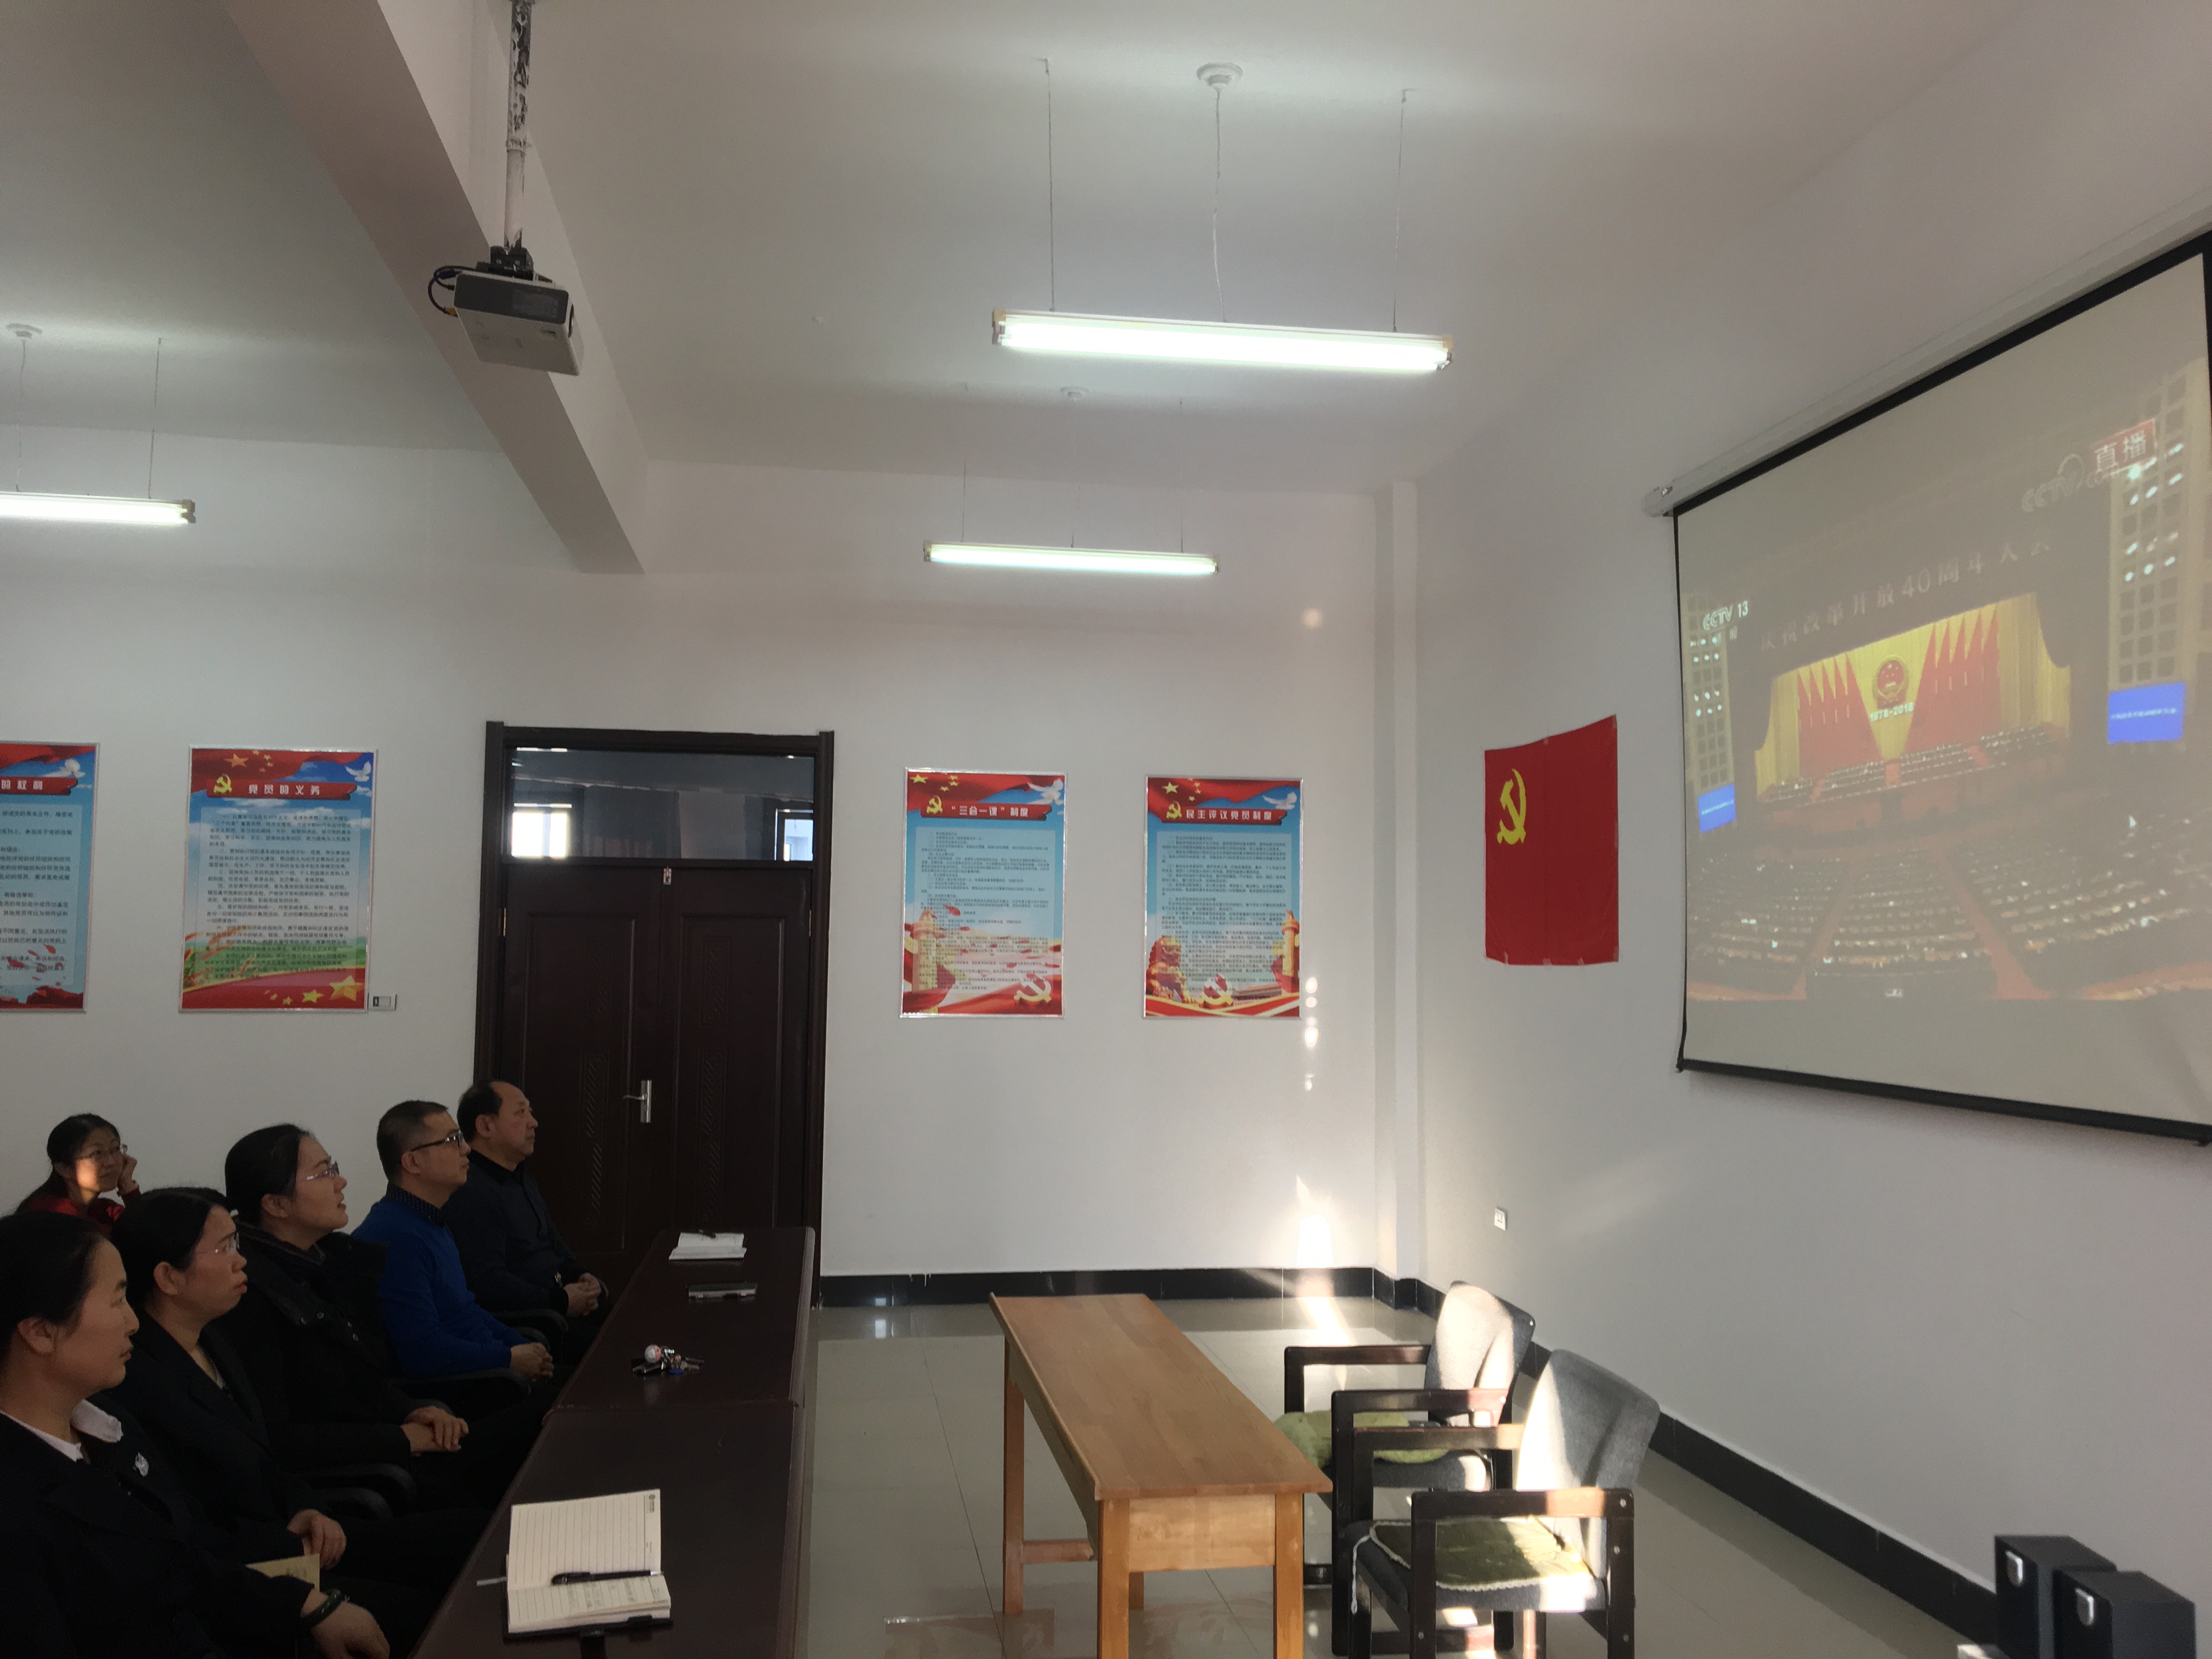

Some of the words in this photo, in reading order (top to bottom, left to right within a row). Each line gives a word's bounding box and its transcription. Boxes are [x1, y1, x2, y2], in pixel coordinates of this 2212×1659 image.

[2095, 430, 2147, 472] 直播
[1702, 604, 1734, 631] CCTV
[1737, 600, 1749, 618] 13
[1869, 702, 1914, 722] 1978-2018
[249, 784, 320, 795] 党员的义务
[1186, 809, 1272, 821] 民主评议党员制度
